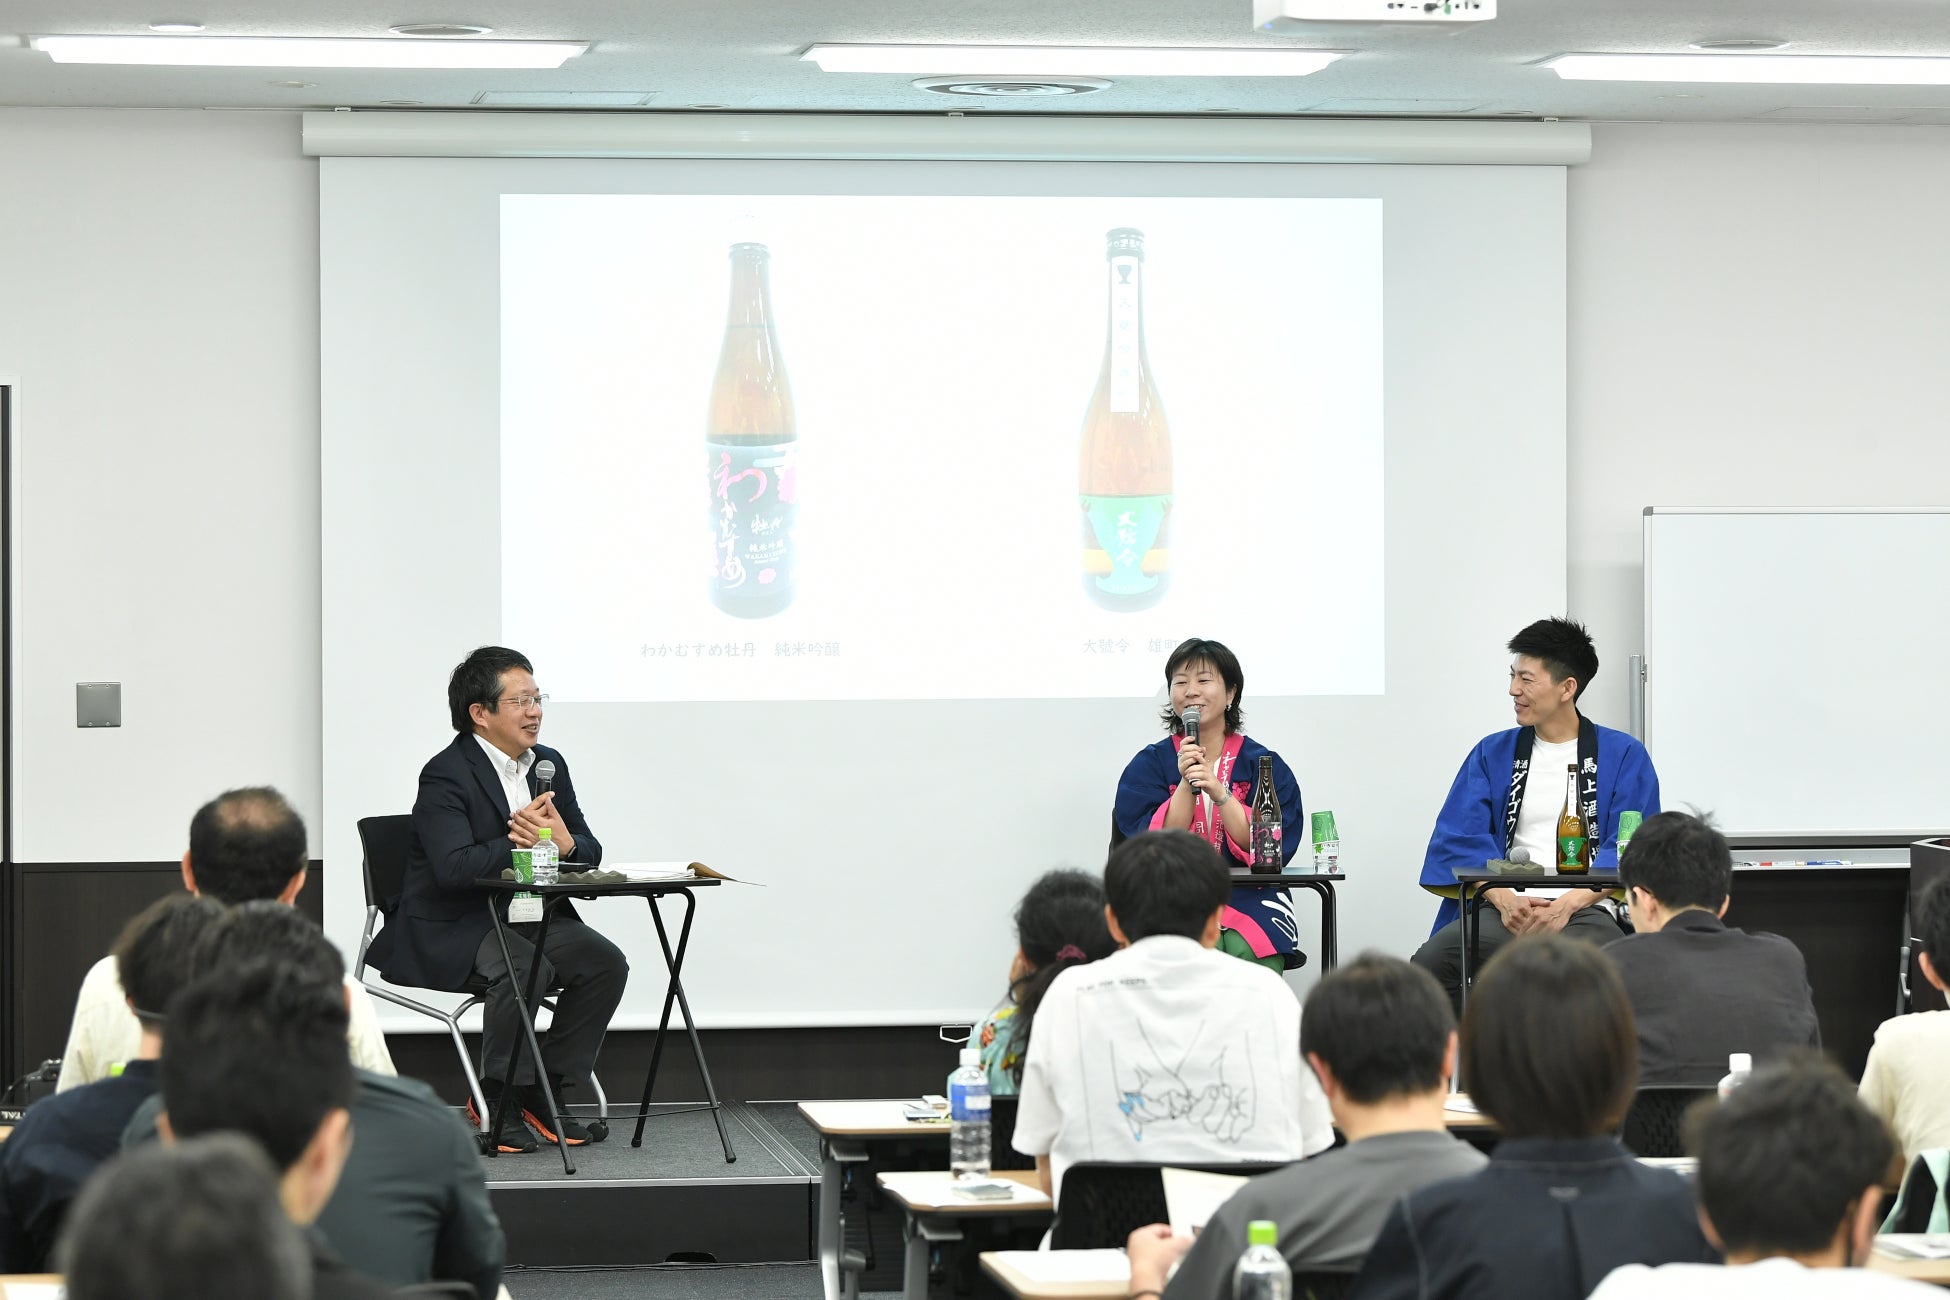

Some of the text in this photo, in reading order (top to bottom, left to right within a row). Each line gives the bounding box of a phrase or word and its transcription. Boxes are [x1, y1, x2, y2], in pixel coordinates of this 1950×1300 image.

[641, 642, 756, 658] わかむすめ牡丹
